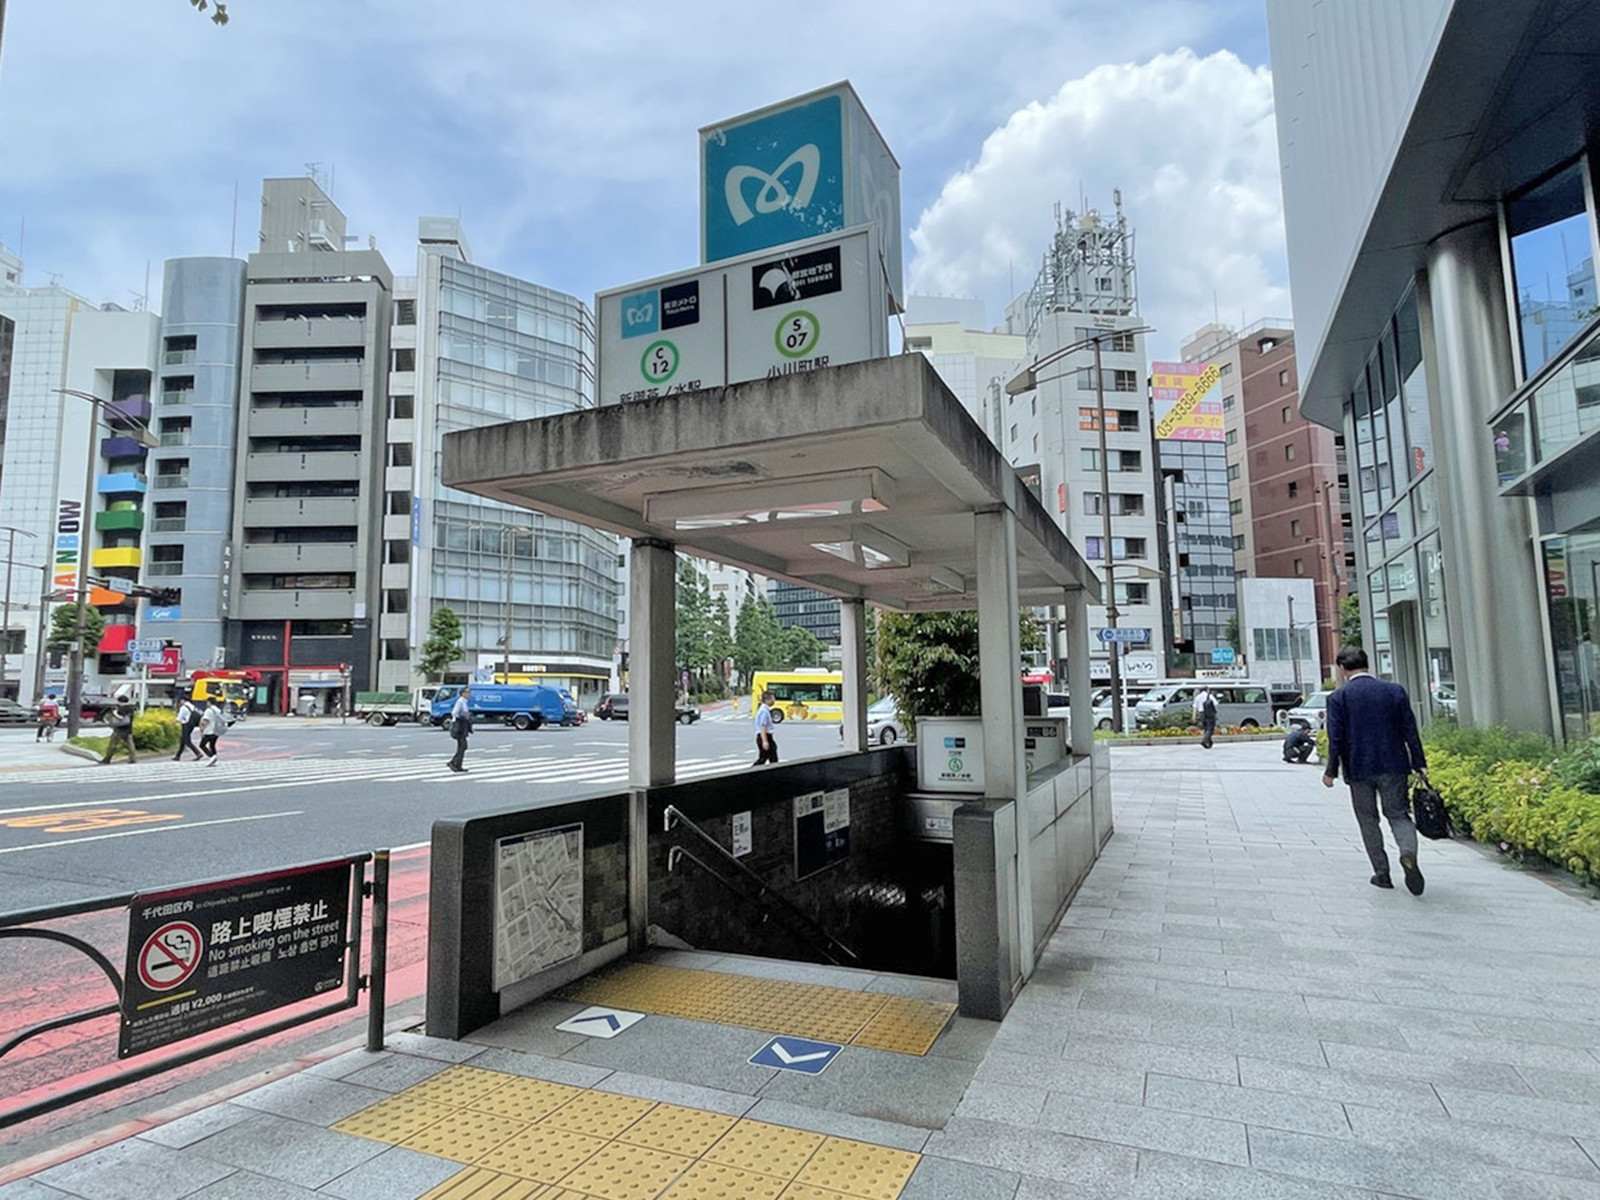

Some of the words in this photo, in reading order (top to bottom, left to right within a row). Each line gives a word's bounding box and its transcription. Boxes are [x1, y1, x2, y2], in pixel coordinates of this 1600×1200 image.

[793, 318, 801, 332] S
[786, 332, 808, 348] 07
[656, 347, 664, 359] C
[652, 360, 669, 375] 12
[142, 900, 194, 920] 千代田区内
[209, 899, 328, 945] 路上喫煙禁止
[209, 949, 226, 962] No
[228, 937, 275, 958] smoking
[277, 933, 292, 944] on
[293, 927, 310, 940] the
[311, 920, 340, 936] street
